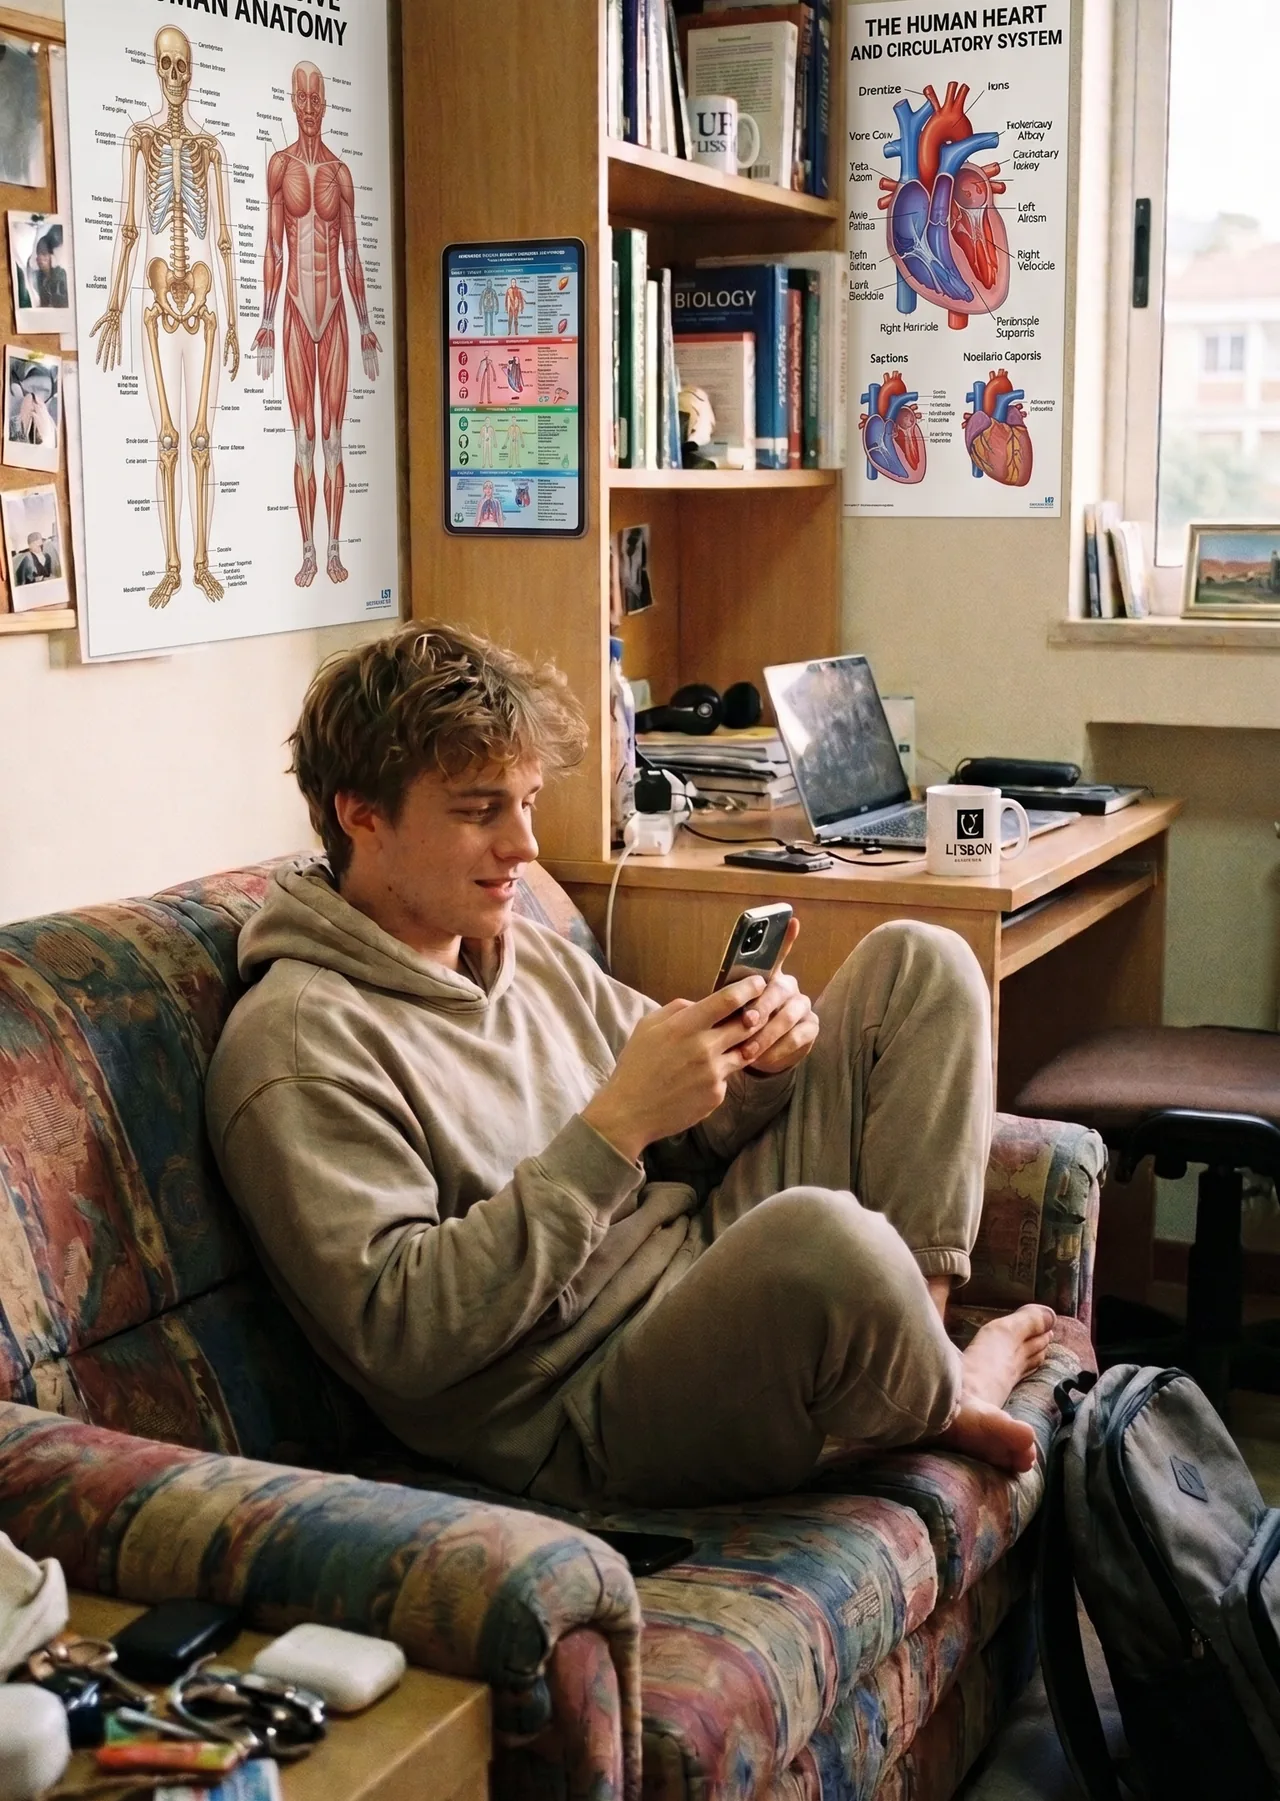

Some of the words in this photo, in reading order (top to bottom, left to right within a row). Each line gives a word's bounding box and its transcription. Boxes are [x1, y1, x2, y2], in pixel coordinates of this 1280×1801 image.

[234, 0, 348, 46] ANATOMY
[865, 17, 901, 37] THE
[908, 11, 976, 33] HUMAN
[983, 5, 1046, 27] HEART
[851, 45, 882, 61] AND
[886, 34, 993, 57] CIRCULATORY
[998, 30, 1062, 48] SYSTEM
[859, 85, 901, 96] Drentize
[849, 132, 870, 140] Vore
[1019, 202, 1035, 211] Left
[1018, 250, 1040, 262] Right
[676, 290, 756, 307] BIOLOGY
